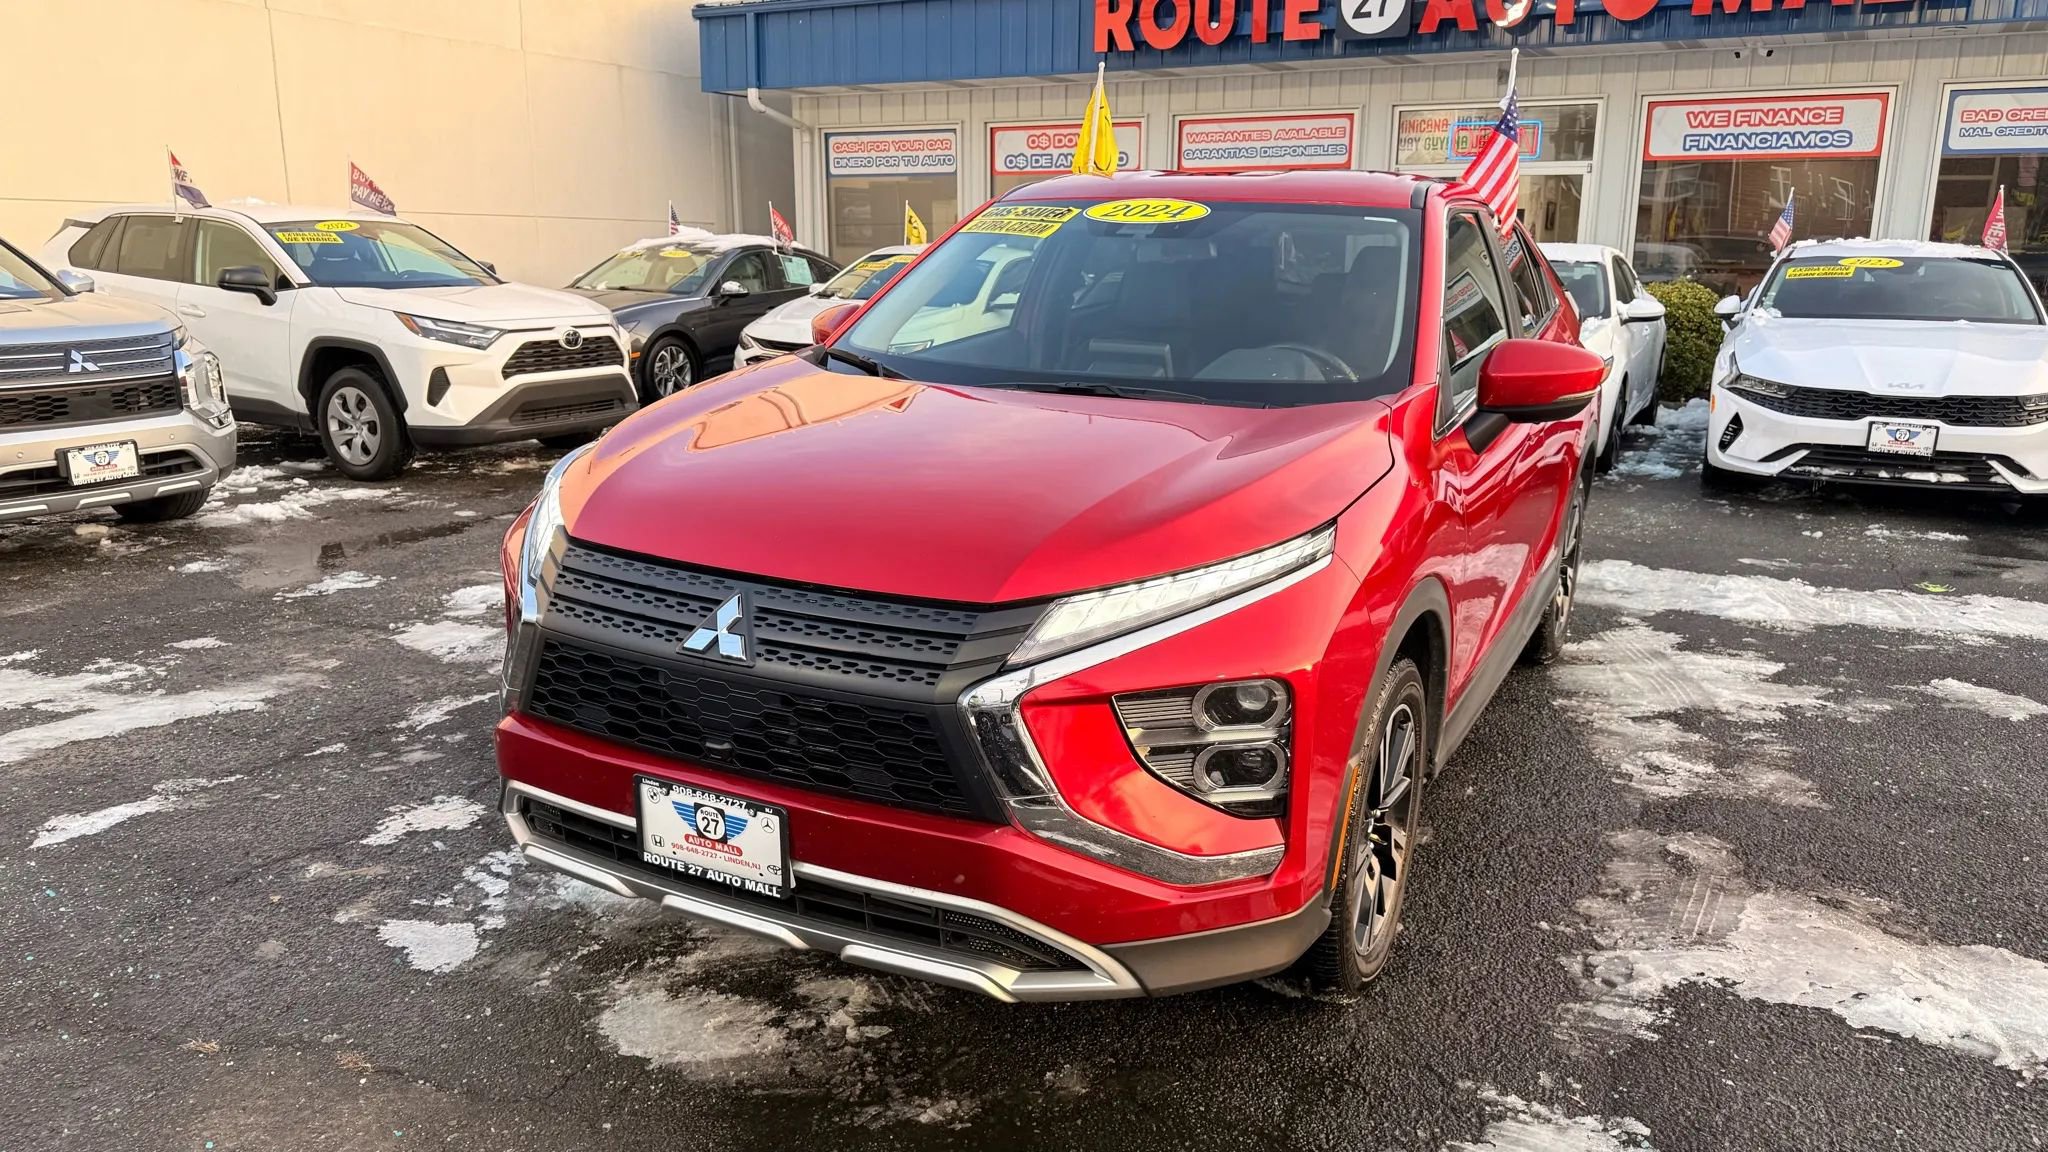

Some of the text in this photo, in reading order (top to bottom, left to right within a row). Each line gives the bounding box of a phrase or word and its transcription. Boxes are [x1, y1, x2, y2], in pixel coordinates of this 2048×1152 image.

[1687, 106, 1844, 128] WE FINANCE
[1961, 108, 2048, 122] BAD CRE
[1187, 127, 1346, 144] WARRANTIES AVAILABLE
[1959, 127, 1993, 137] MAL
[833, 139, 951, 153] CASH FOR YOUR CAR
[1454, 126, 1538, 156] OPN
[1683, 130, 1852, 151] FINANCIAMOS
[1184, 144, 1347, 160] GARANTIAS DISPONIBLES
[833, 154, 955, 168] DINERO POR TU AUTO
[1031, 153, 1053, 168] DE
[351, 183, 370, 199] PAY
[1103, 203, 1186, 218] 2024
[966, 220, 1055, 234] EXTRA CLEAN
[1898, 432, 1908, 440] 27
[97, 455, 107, 464] 27
[642, 778, 660, 787] Linden
[672, 785, 747, 810] 908-648-2727
[700, 808, 719, 819] ROUTE
[701, 816, 720, 836] 27
[671, 842, 718, 859] 908-648-2727
[688, 836, 740, 856] AUTO MALL
[643, 851, 781, 898] ROUTE 27 AUTO MALL
